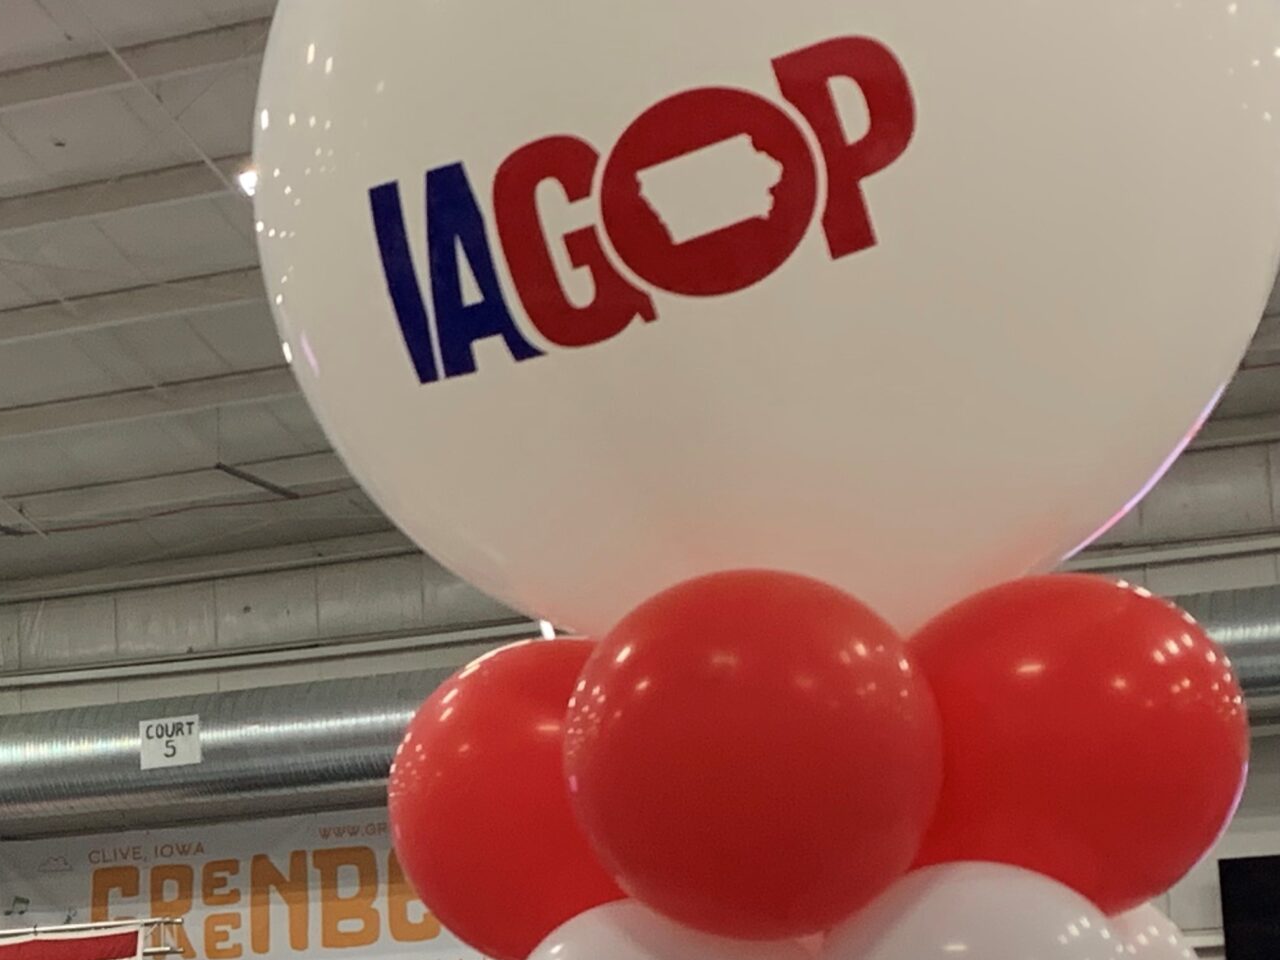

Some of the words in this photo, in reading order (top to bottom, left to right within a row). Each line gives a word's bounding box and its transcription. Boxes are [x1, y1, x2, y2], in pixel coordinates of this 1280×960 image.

[368, 35, 917, 384] IAGOP
[146, 721, 195, 740] COURT
[164, 740, 177, 758] 5
[87, 845, 149, 865] CLIVE,
[153, 840, 206, 860] IOWA
